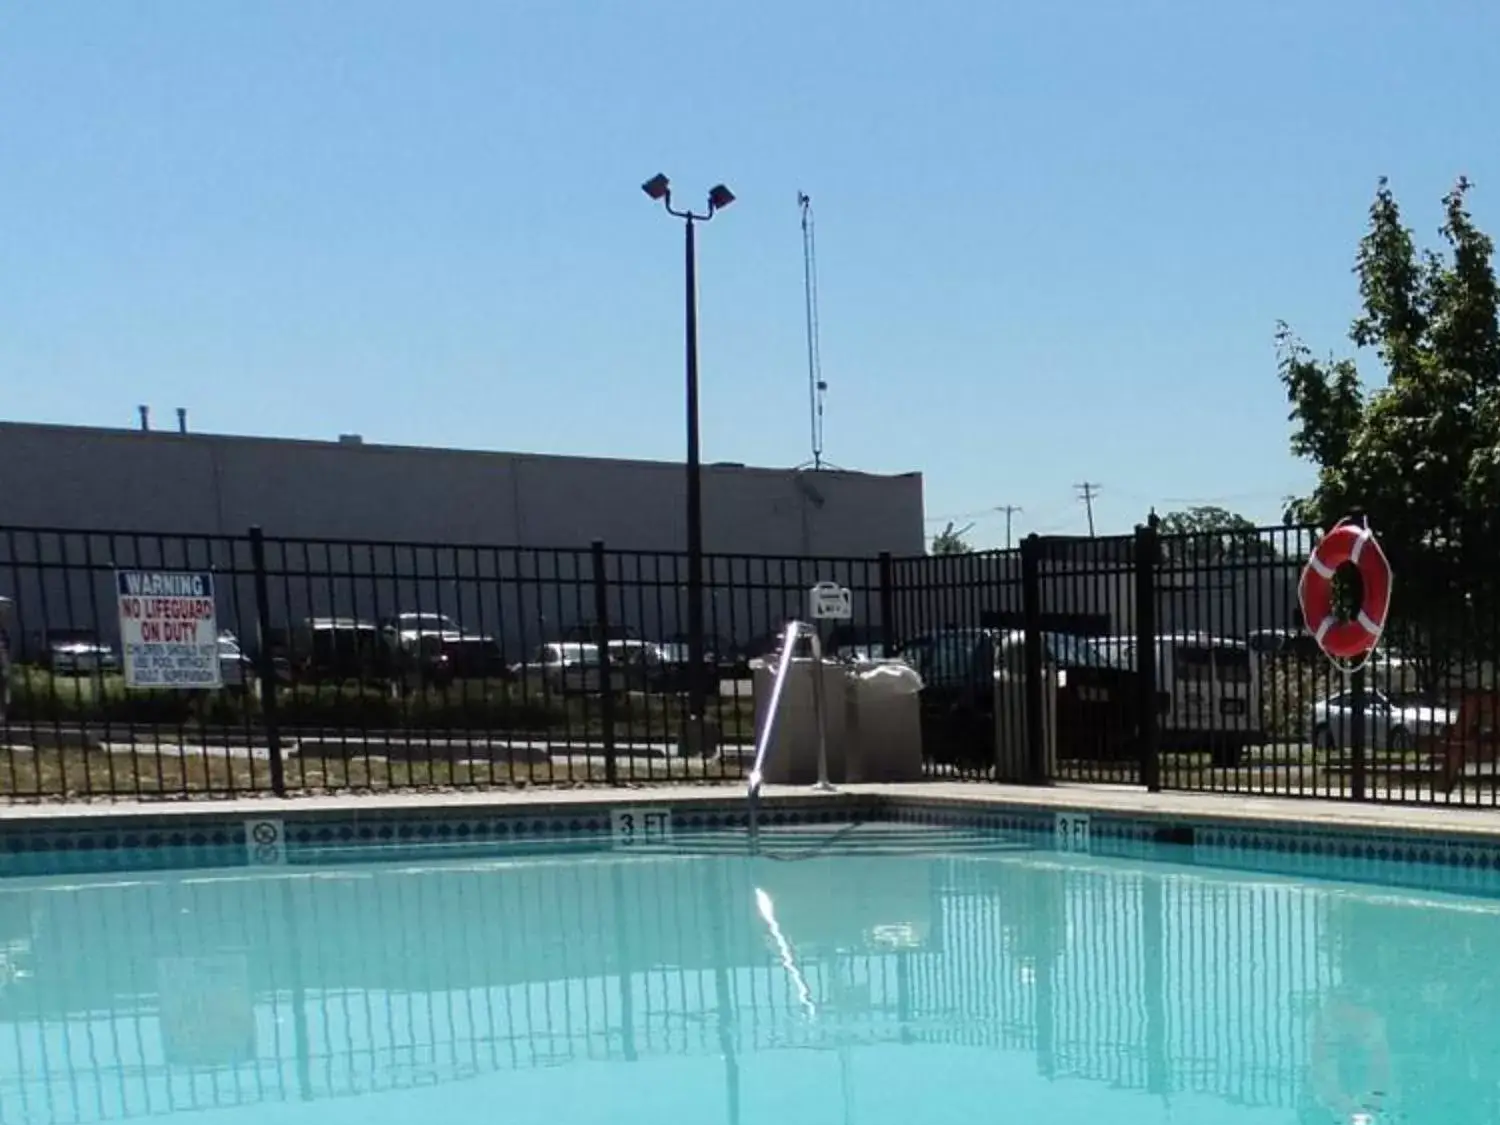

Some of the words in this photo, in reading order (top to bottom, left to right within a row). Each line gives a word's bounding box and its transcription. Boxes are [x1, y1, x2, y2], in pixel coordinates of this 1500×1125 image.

[125, 574, 203, 595] WARNING
[122, 599, 140, 618] NO
[145, 599, 211, 619] LIFEGUARD
[141, 621, 160, 641] ON
[164, 621, 197, 641] DUTY
[620, 813, 634, 836] 3
[645, 812, 668, 837] FT
[1073, 819, 1088, 838] FT
